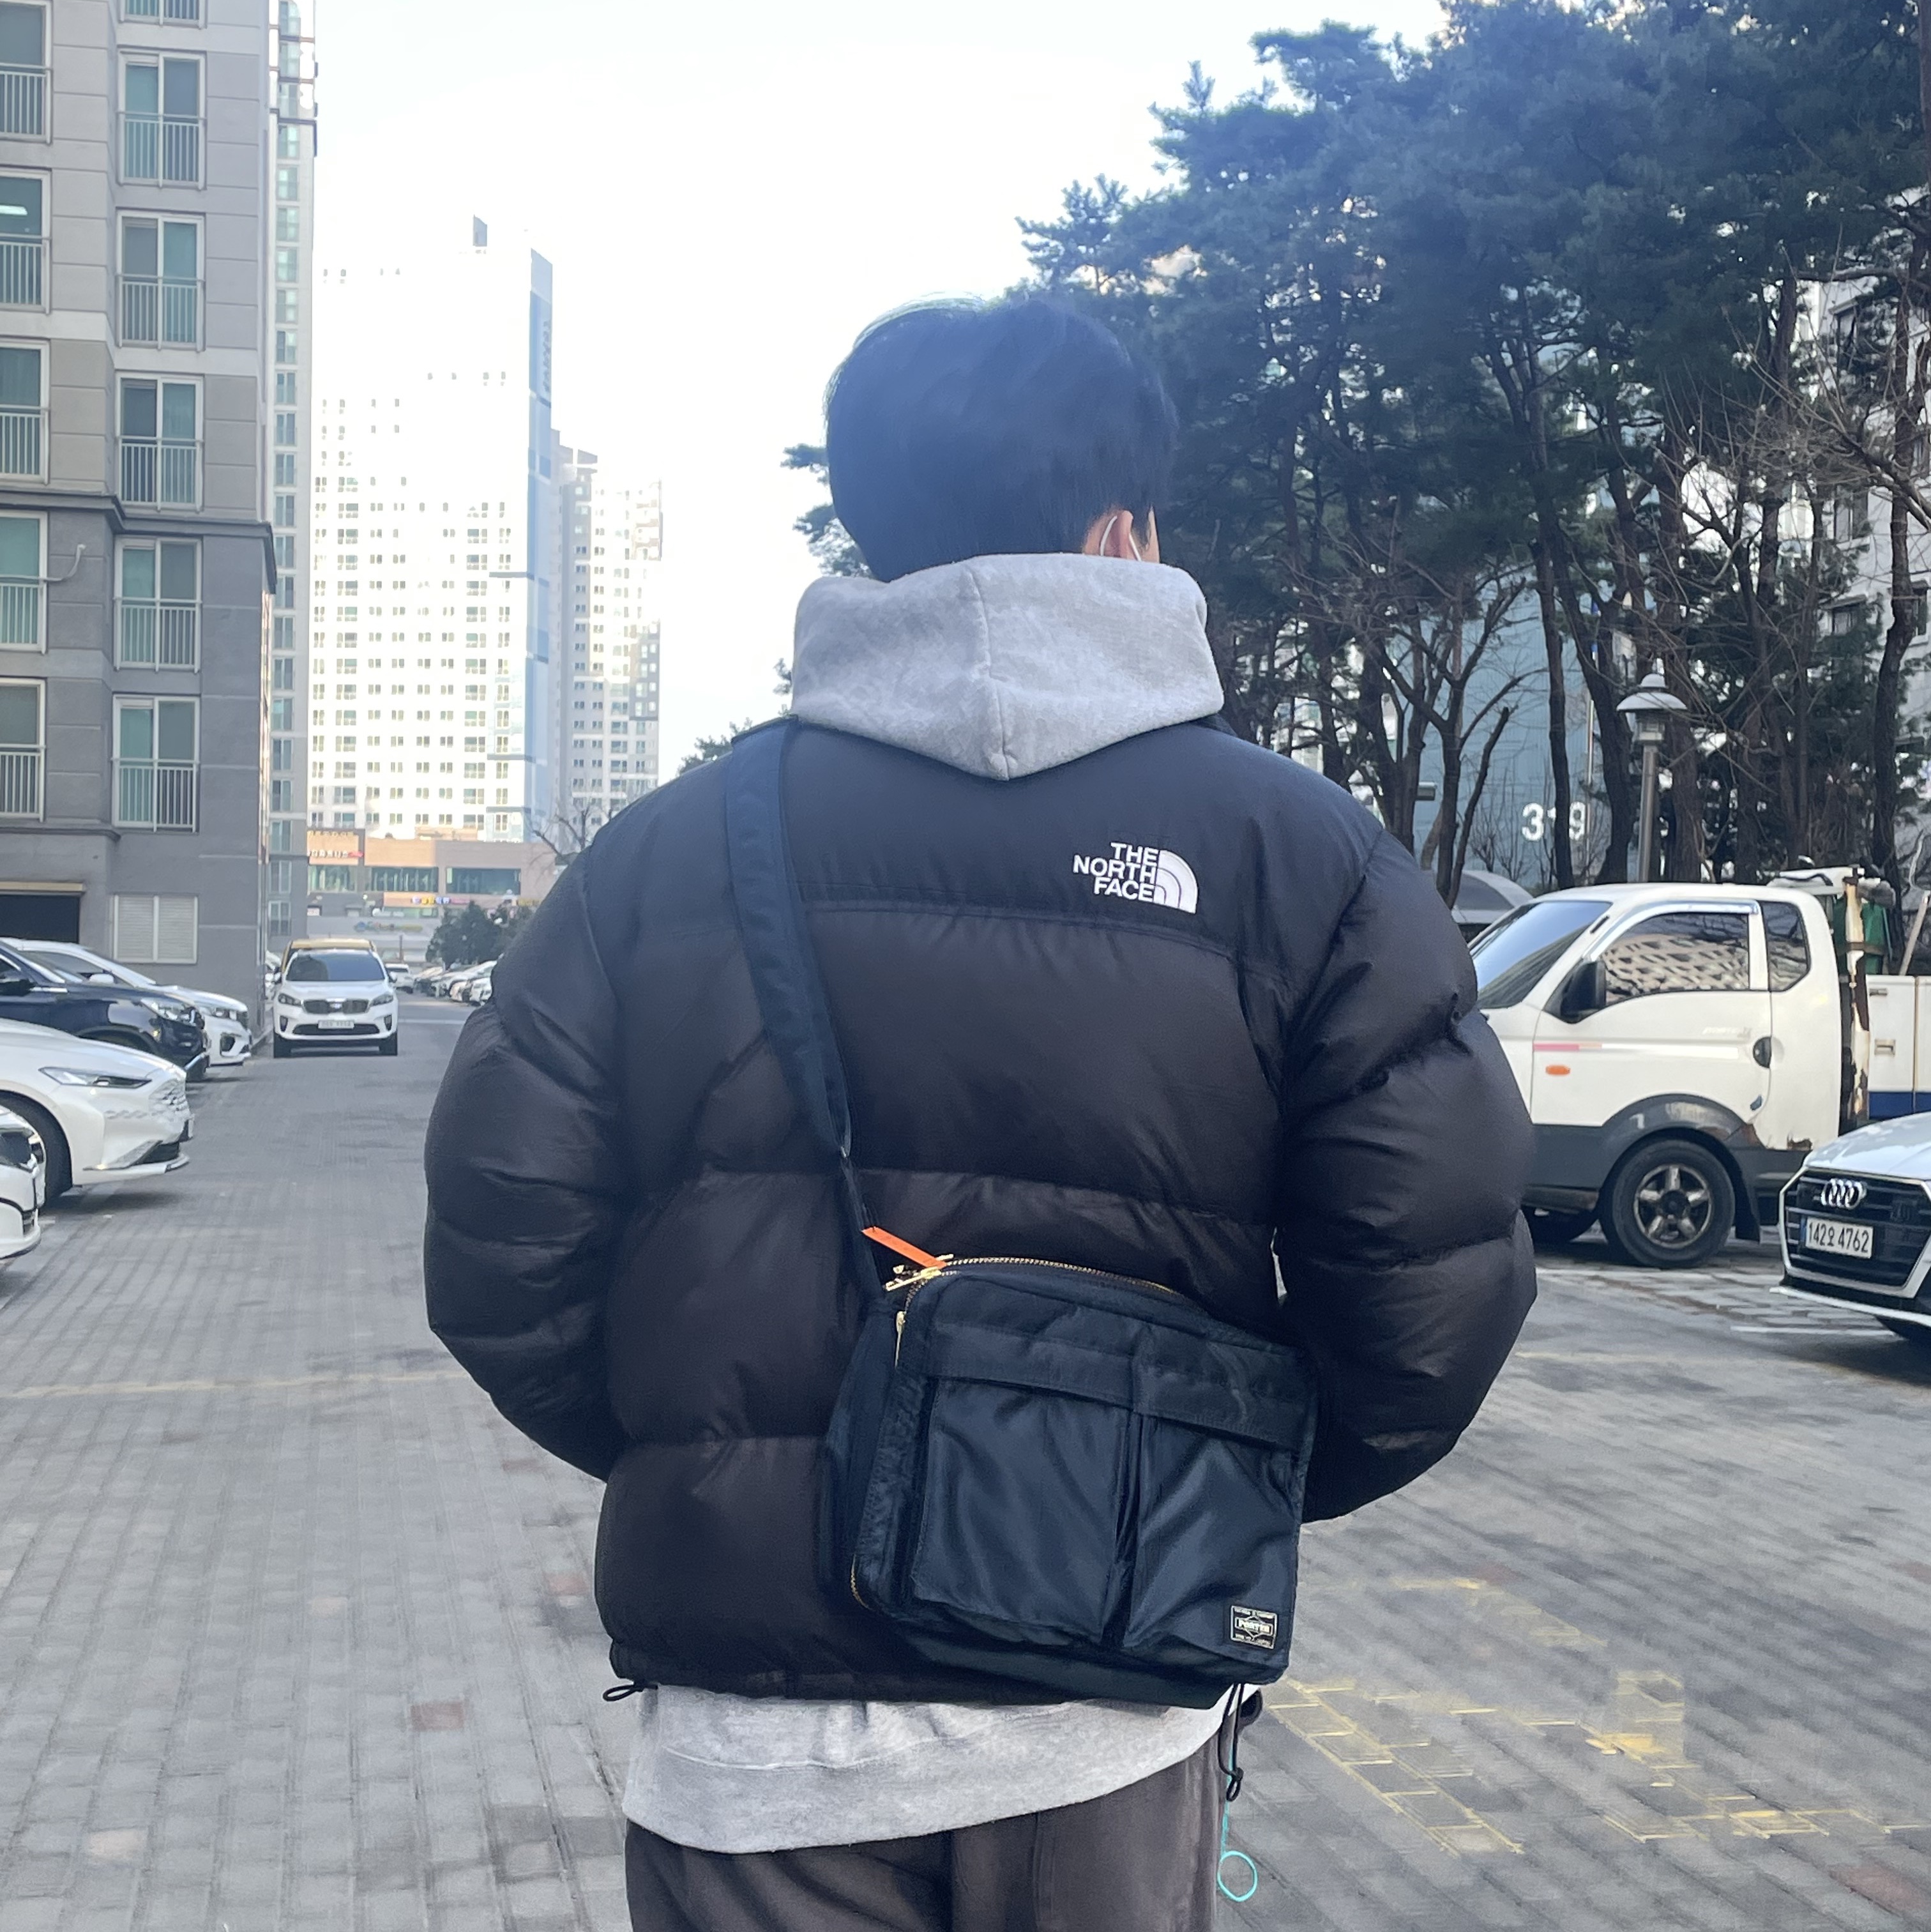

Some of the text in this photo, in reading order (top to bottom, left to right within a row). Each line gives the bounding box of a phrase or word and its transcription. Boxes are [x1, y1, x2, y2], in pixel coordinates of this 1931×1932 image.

[1110, 842, 1158, 867] THE
[1073, 855, 1156, 885] NORTH
[1093, 877, 1154, 902] FACE
[1838, 1227, 1870, 1253] 4762
